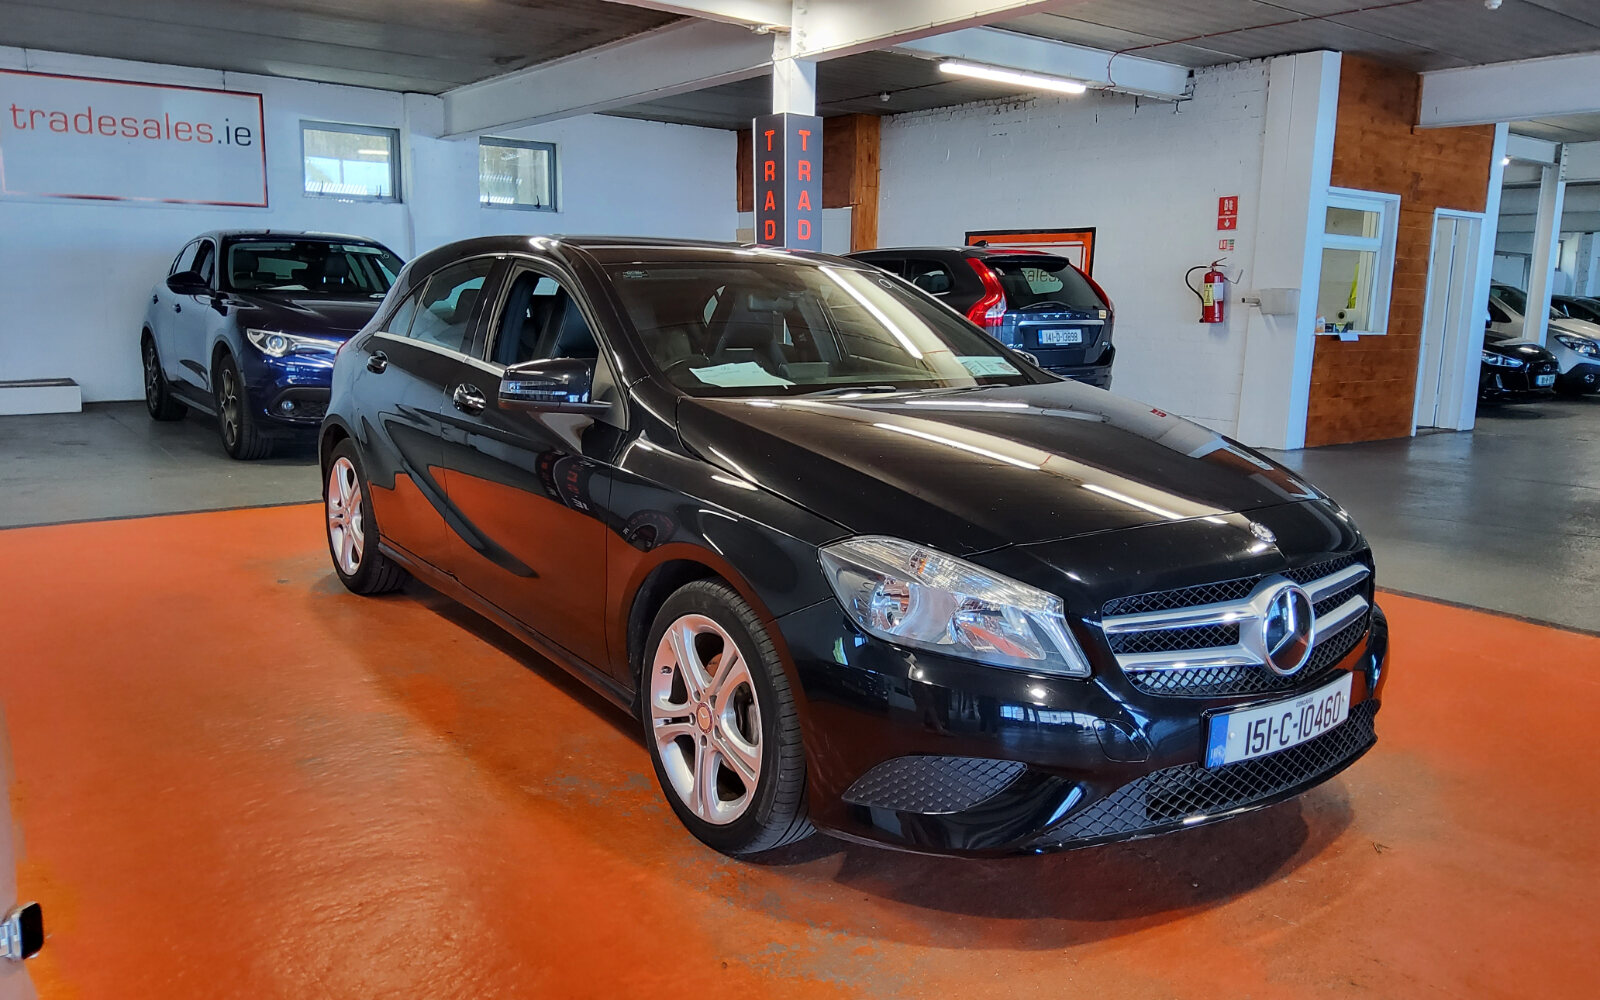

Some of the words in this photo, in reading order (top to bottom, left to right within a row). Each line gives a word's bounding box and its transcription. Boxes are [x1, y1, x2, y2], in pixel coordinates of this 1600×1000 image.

[9, 103, 252, 147] tradesales.ie
[764, 129, 776, 241] TRAD
[797, 129, 812, 241] TRAD
[1244, 691, 1342, 756] 151-C-10460
